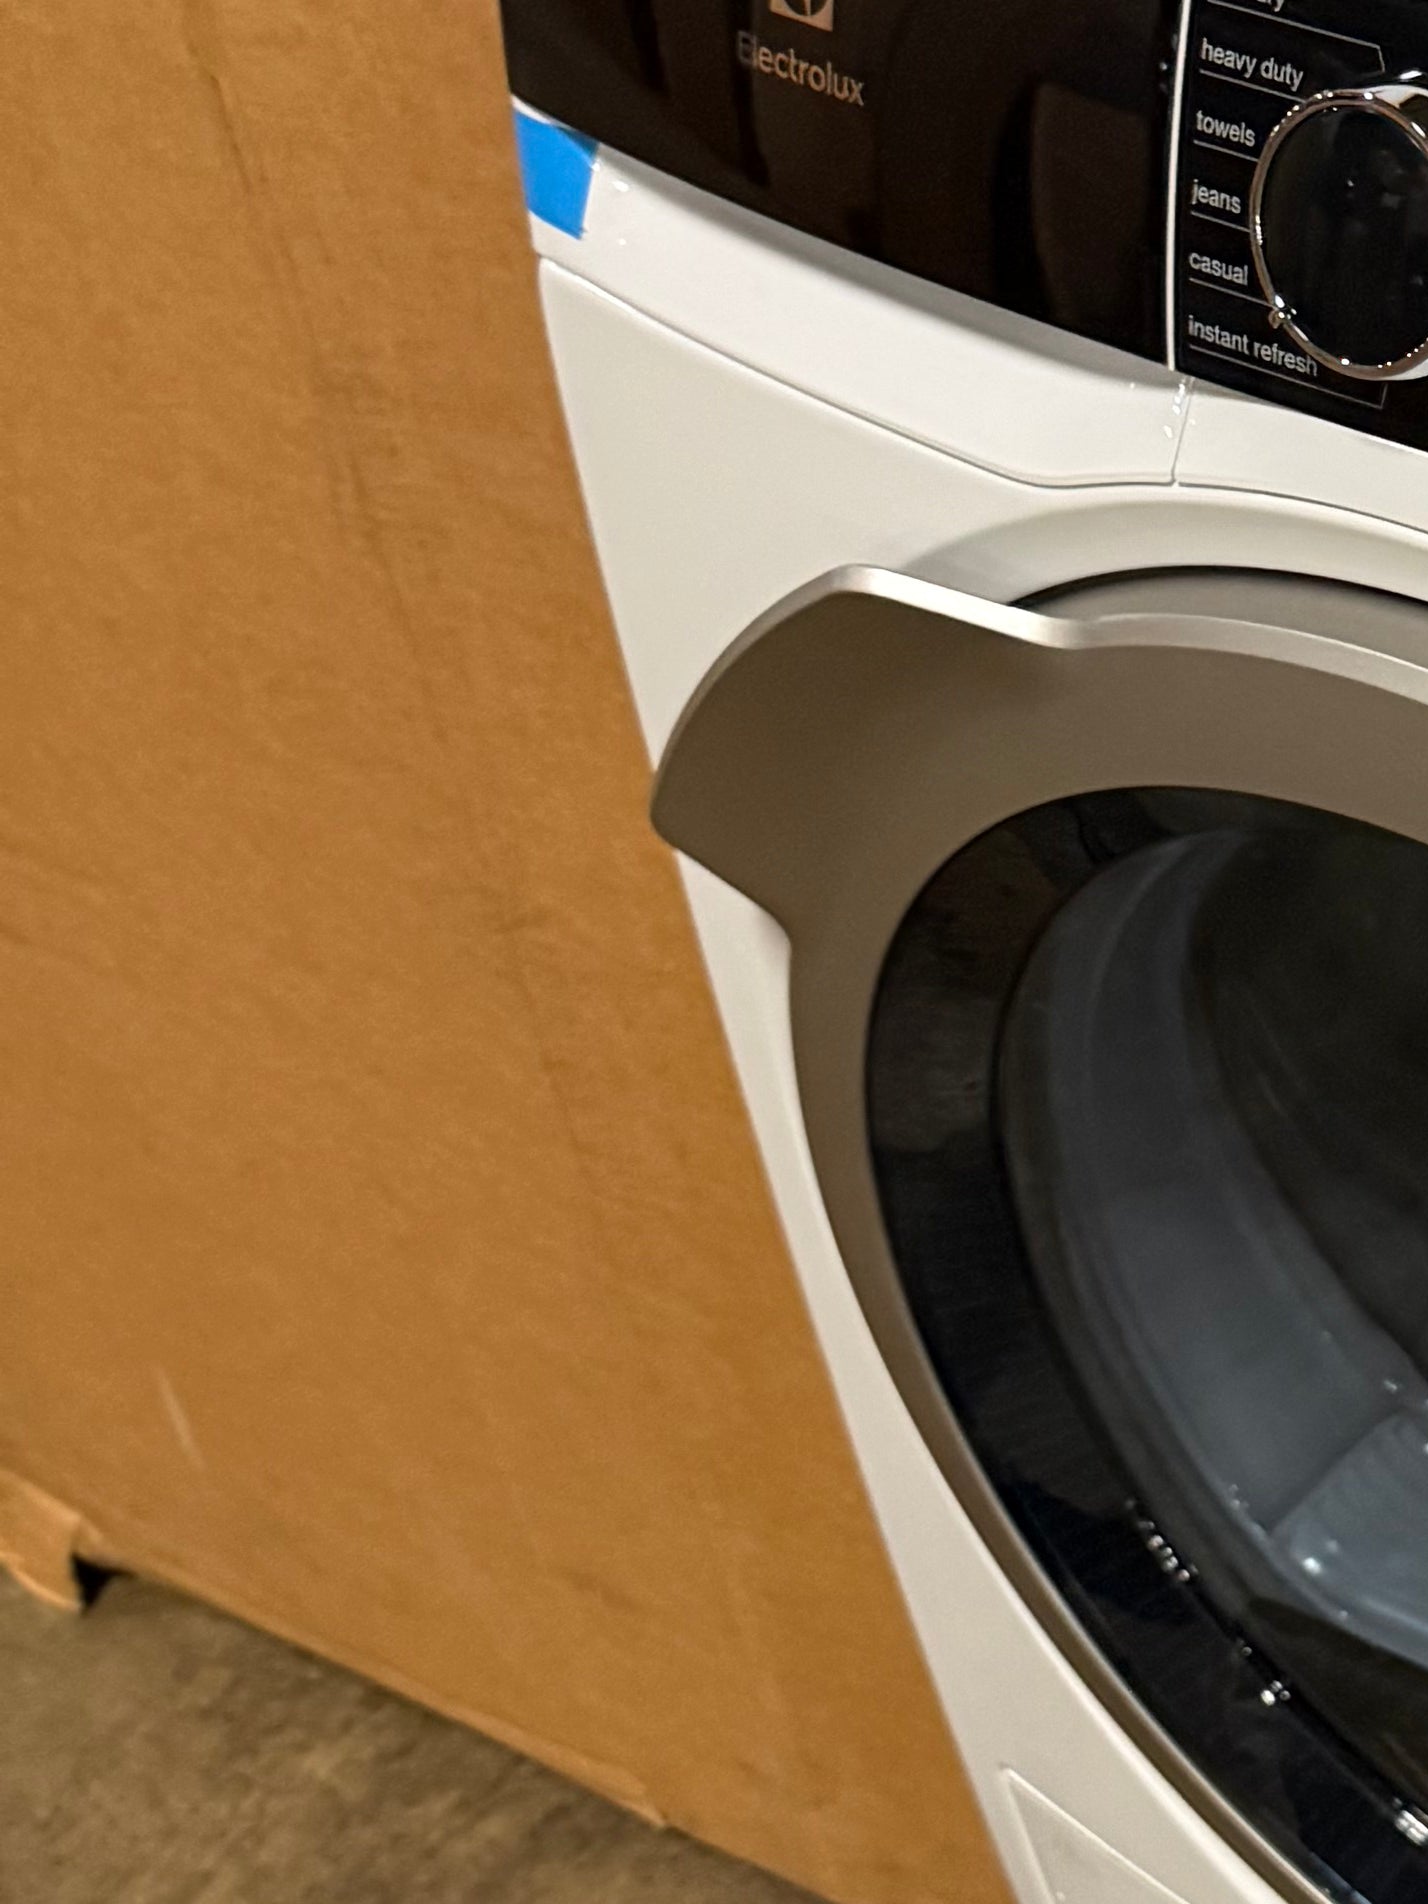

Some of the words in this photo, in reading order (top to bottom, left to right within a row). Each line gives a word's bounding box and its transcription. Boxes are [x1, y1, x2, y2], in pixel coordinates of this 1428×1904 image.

[736, 30, 865, 107] Electrolux
[1201, 38, 1257, 79] heavy
[1260, 56, 1304, 91] duty
[1196, 109, 1256, 147] towels
[1191, 179, 1242, 214] jeans
[1188, 250, 1249, 286] casual
[1188, 315, 1249, 355] instant
[1253, 338, 1318, 377] refresh
